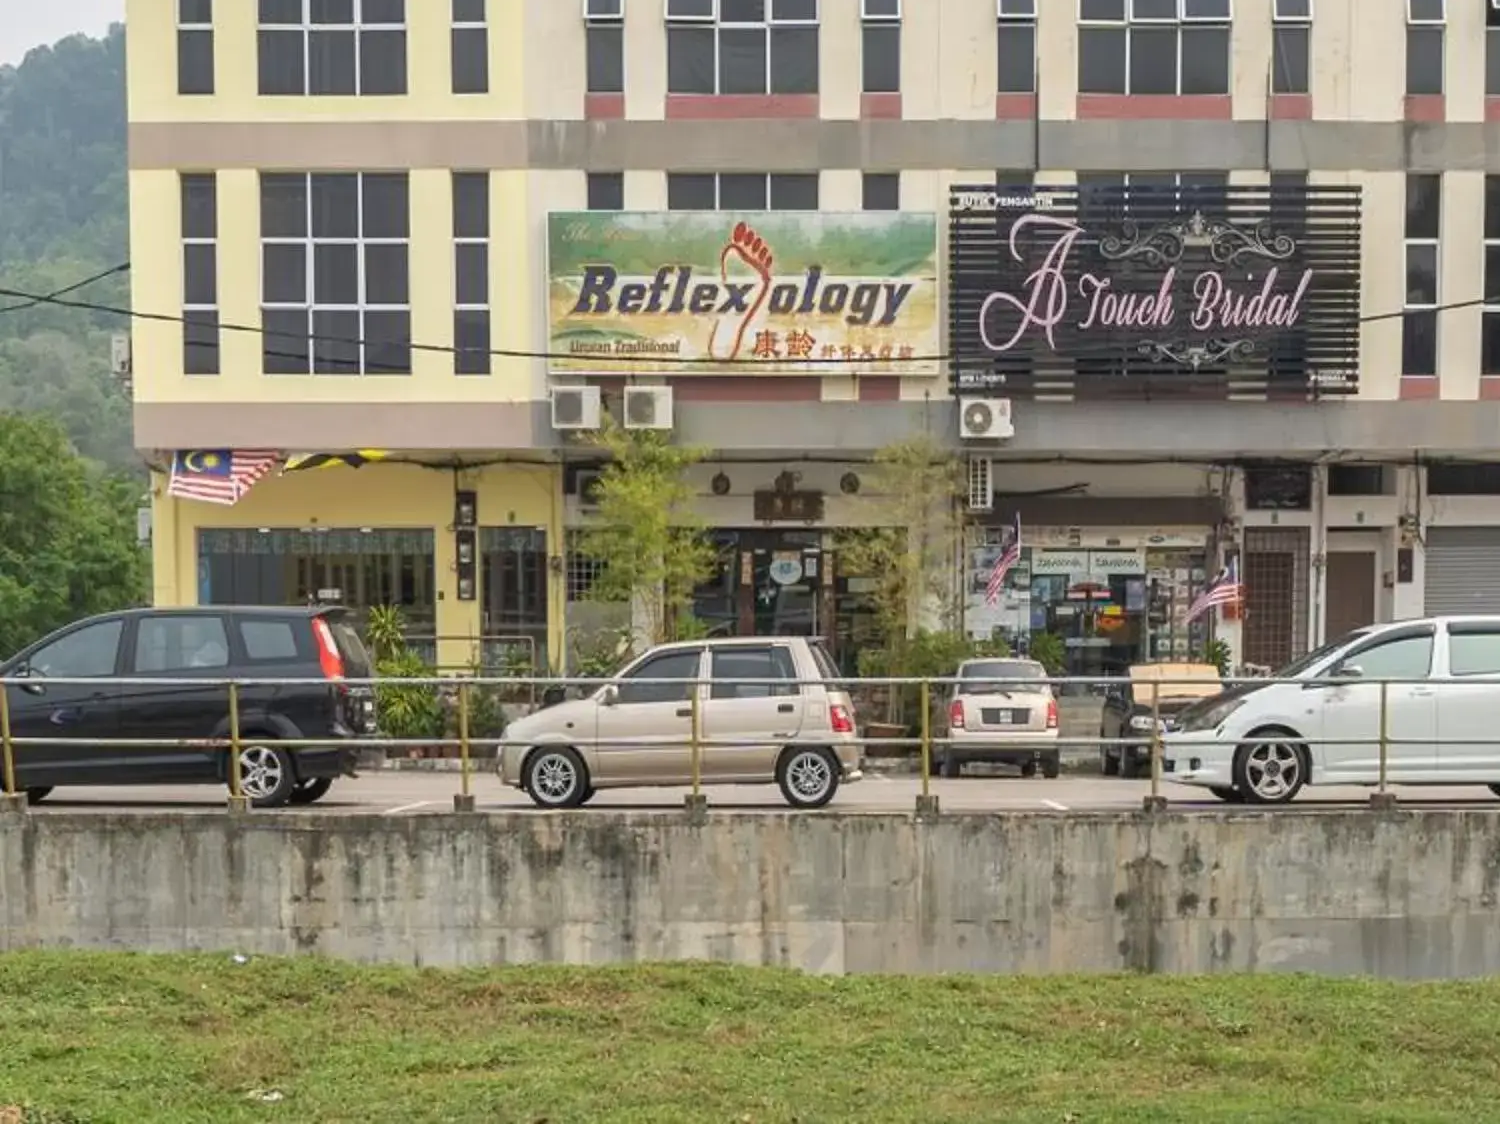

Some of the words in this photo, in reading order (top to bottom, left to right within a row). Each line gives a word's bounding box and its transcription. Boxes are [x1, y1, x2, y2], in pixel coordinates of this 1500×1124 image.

[979, 214, 1087, 352] A
[1078, 266, 1177, 330] Touch
[1190, 267, 1313, 331] Bridal
